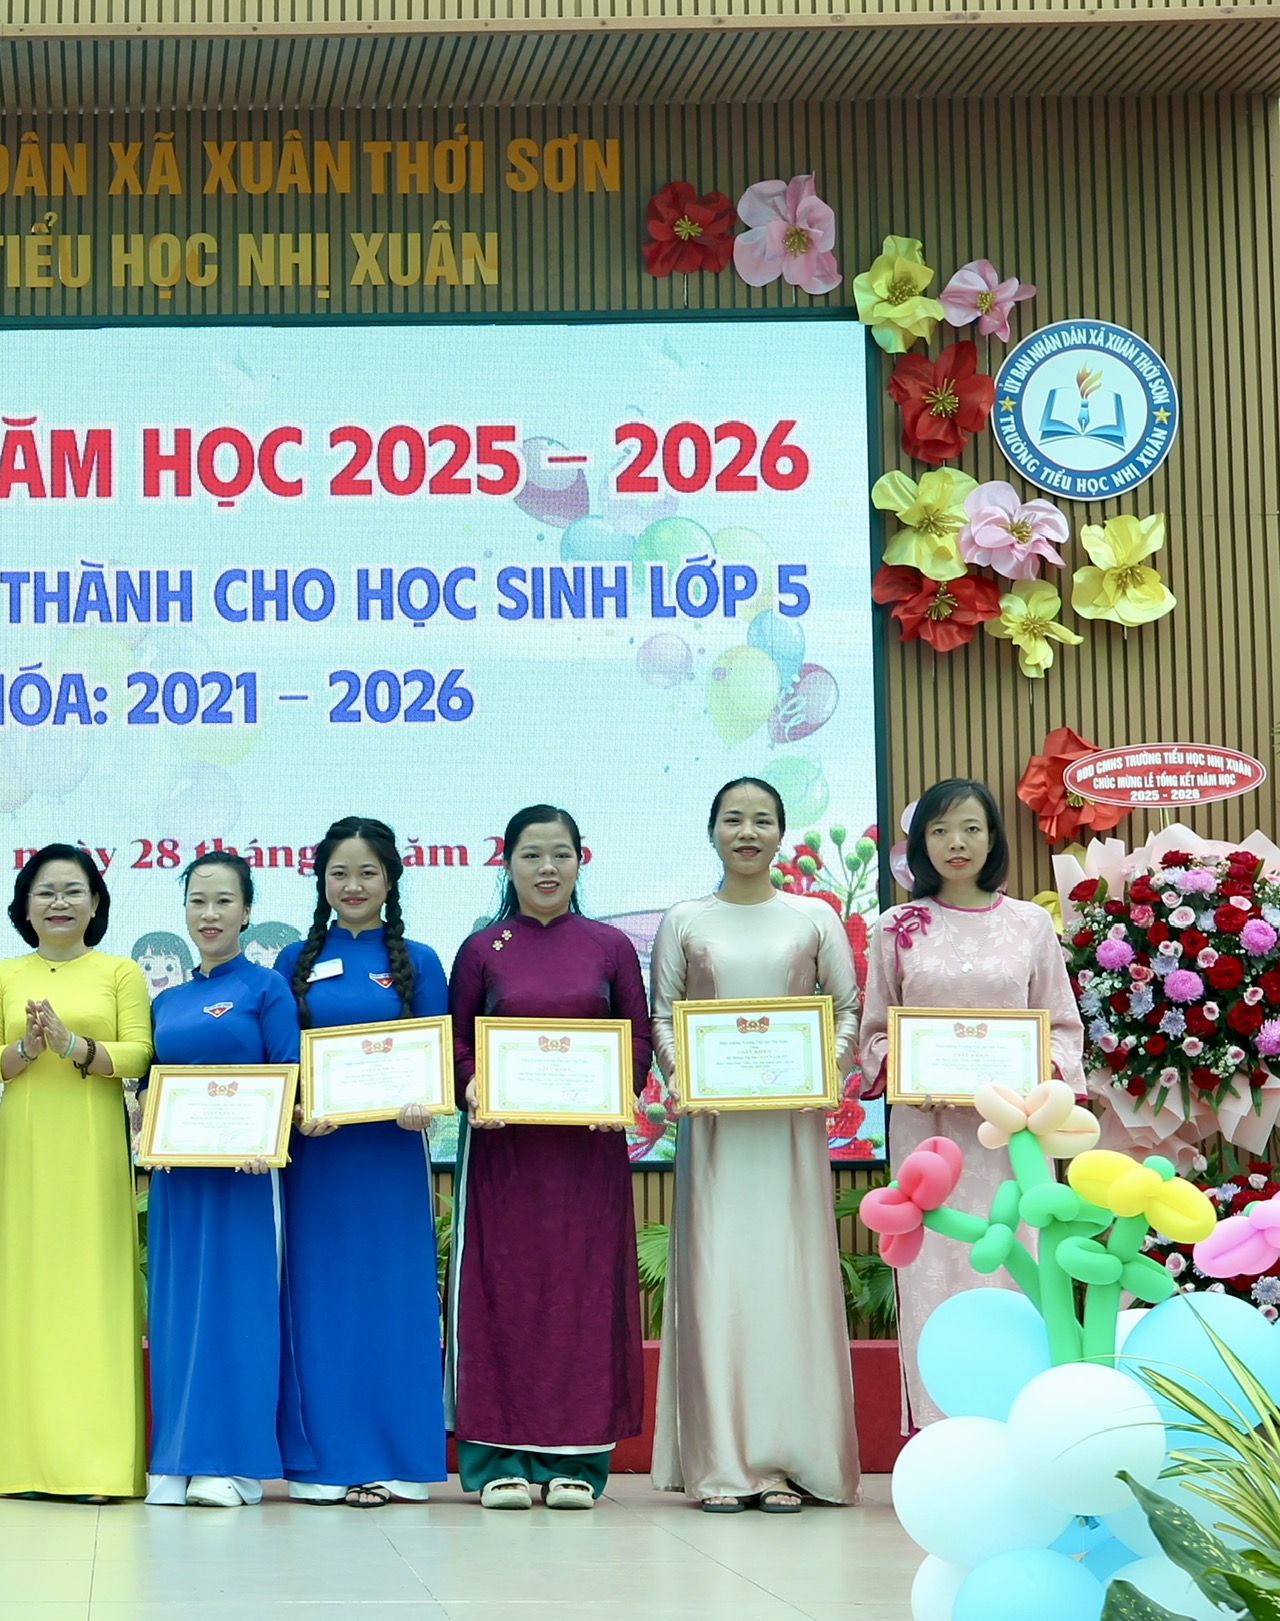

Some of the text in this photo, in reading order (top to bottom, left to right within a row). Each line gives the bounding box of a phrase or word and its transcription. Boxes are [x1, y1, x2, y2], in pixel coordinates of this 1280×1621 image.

[107, 131, 183, 196] XÃ
[202, 129, 351, 195] XUÂN
[363, 123, 484, 195] THỚI
[504, 133, 620, 194] SƠN
[111, 231, 219, 299] HỌC
[237, 232, 331, 299] NHỊ
[350, 219, 498, 287] XUÂN
[1010, 354, 1036, 381] BAN
[1026, 333, 1062, 362] NHÂN
[1060, 326, 1086, 347] DÂN
[1088, 327, 1106, 347] XÃ
[1105, 332, 1140, 361] XUÂN
[1133, 351, 1161, 382] THỚI
[1148, 377, 1170, 405] SƠN
[142, 425, 303, 508] HỌC
[328, 424, 521, 496] 2025
[615, 419, 811, 494] 2026
[999, 414, 1168, 496] TRƯỜNG TIỂU HỌC NHỊ XUÂN
[0, 559, 193, 625] THÀNH
[214, 566, 337, 623] CHO
[356, 565, 477, 628] HỌC
[495, 564, 628, 621] SINH
[649, 553, 759, 620] LỚP
[777, 563, 811, 618] 5
[126, 670, 258, 726] 2021
[328, 668, 476, 725] 2026
[1093, 770, 1236, 790] CHÚC MỪNG LỄ TỔNG KẾT NĂM HỌC
[1096, 756, 1123, 775] CMHS
[1124, 750, 1162, 768] TRƯỜNG
[1163, 747, 1184, 764] TIỂU
[1185, 752, 1205, 768] HỌC
[1206, 754, 1224, 772] NHỊ
[1225, 757, 1252, 778] XUÂN
[1130, 790, 1160, 801] 2025
[1170, 789, 1200, 800] 2026
[130, 838, 181, 869] 28
[401, 837, 469, 867] ăm
